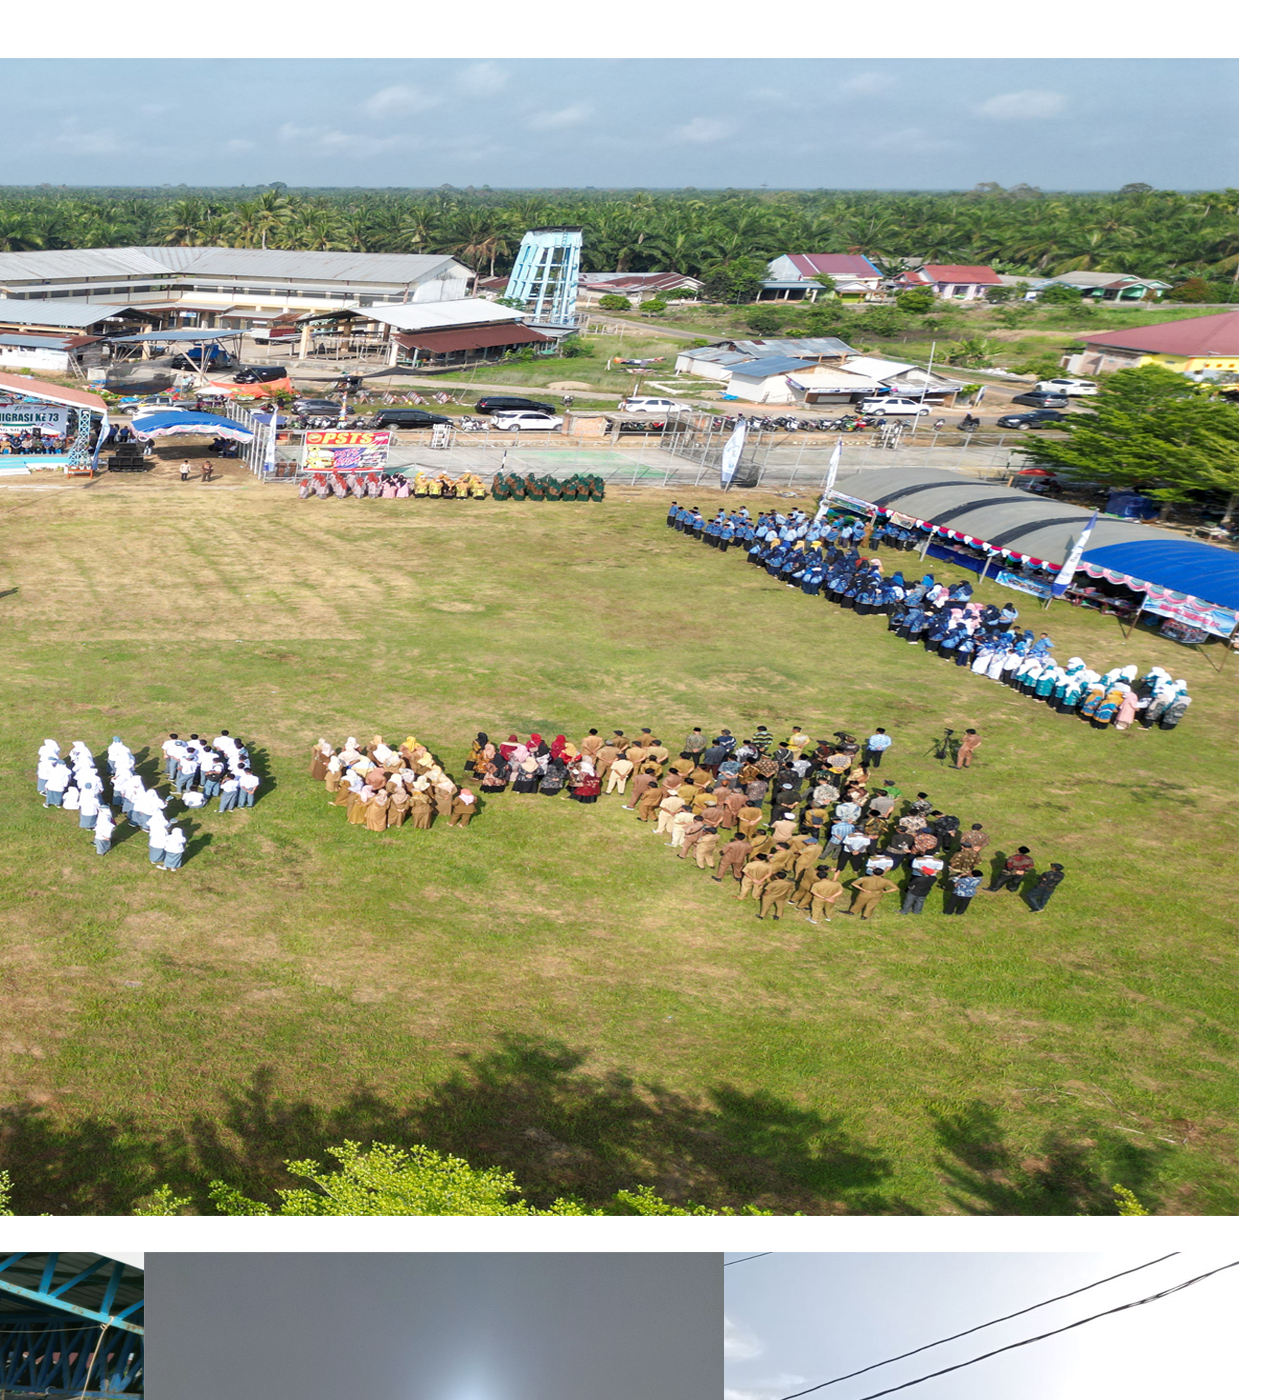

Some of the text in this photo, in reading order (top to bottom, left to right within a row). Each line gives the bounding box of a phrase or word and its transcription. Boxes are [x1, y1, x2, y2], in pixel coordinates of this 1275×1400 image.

[35, 413, 47, 422] KE
[49, 412, 60, 422] 73
[322, 432, 376, 444] PSTS
